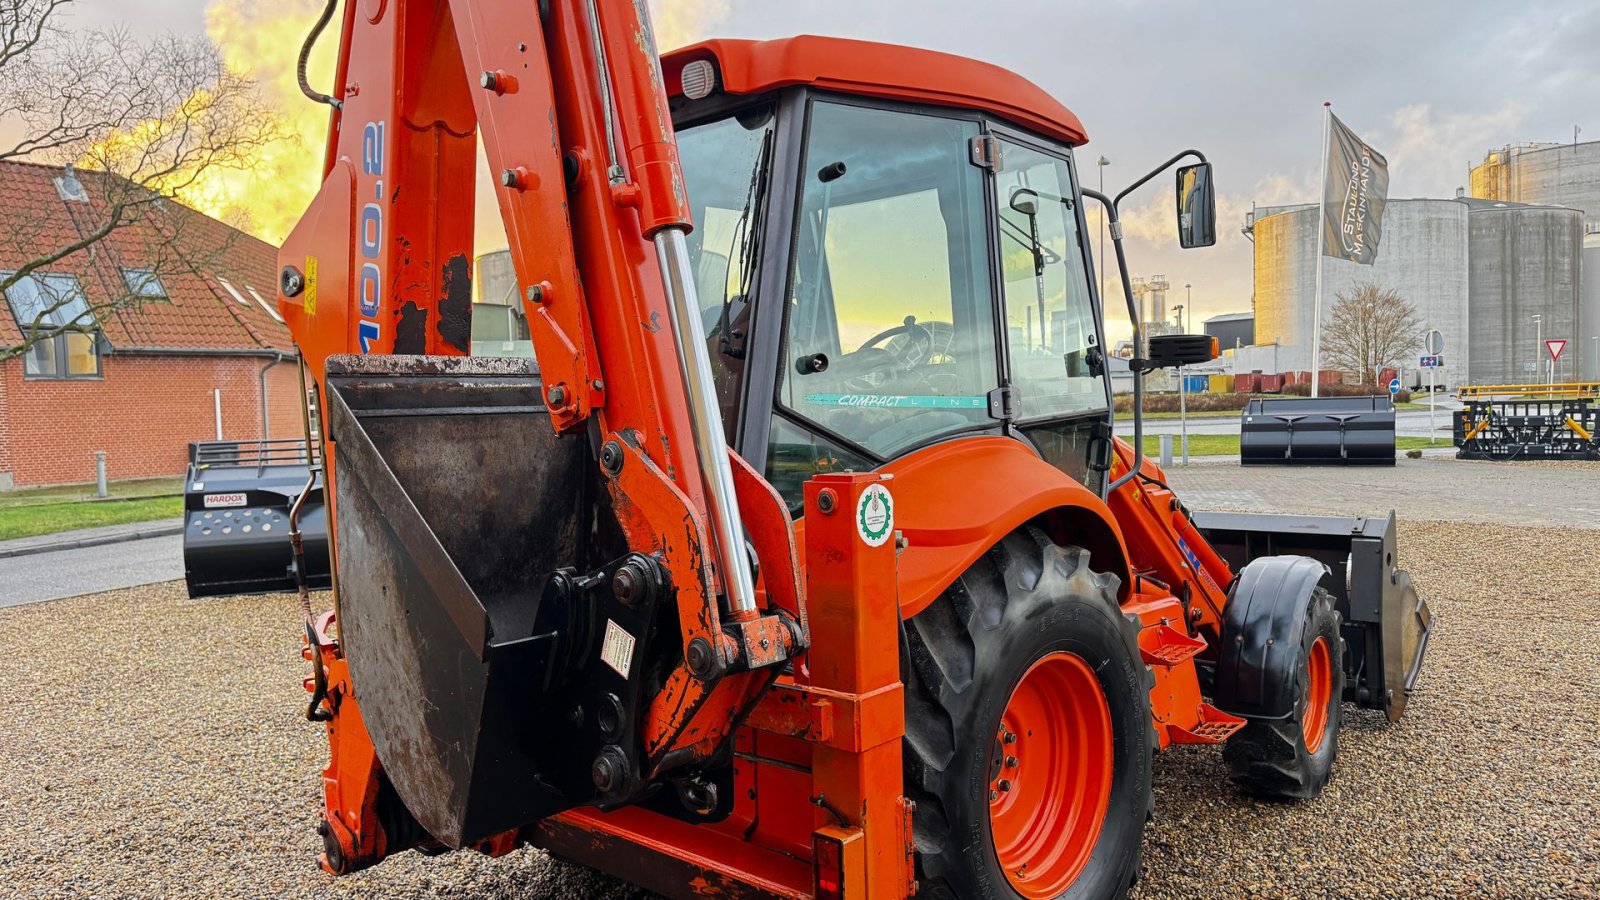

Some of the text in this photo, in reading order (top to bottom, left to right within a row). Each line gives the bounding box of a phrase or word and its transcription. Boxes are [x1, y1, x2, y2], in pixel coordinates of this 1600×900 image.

[1344, 160, 1360, 235] STAULUND
[1352, 147, 1371, 255] MASKINHANDE
[358, 120, 385, 355] 100.2
[838, 394, 981, 407] COMPACT LINE
[206, 494, 244, 503] HARDOX
